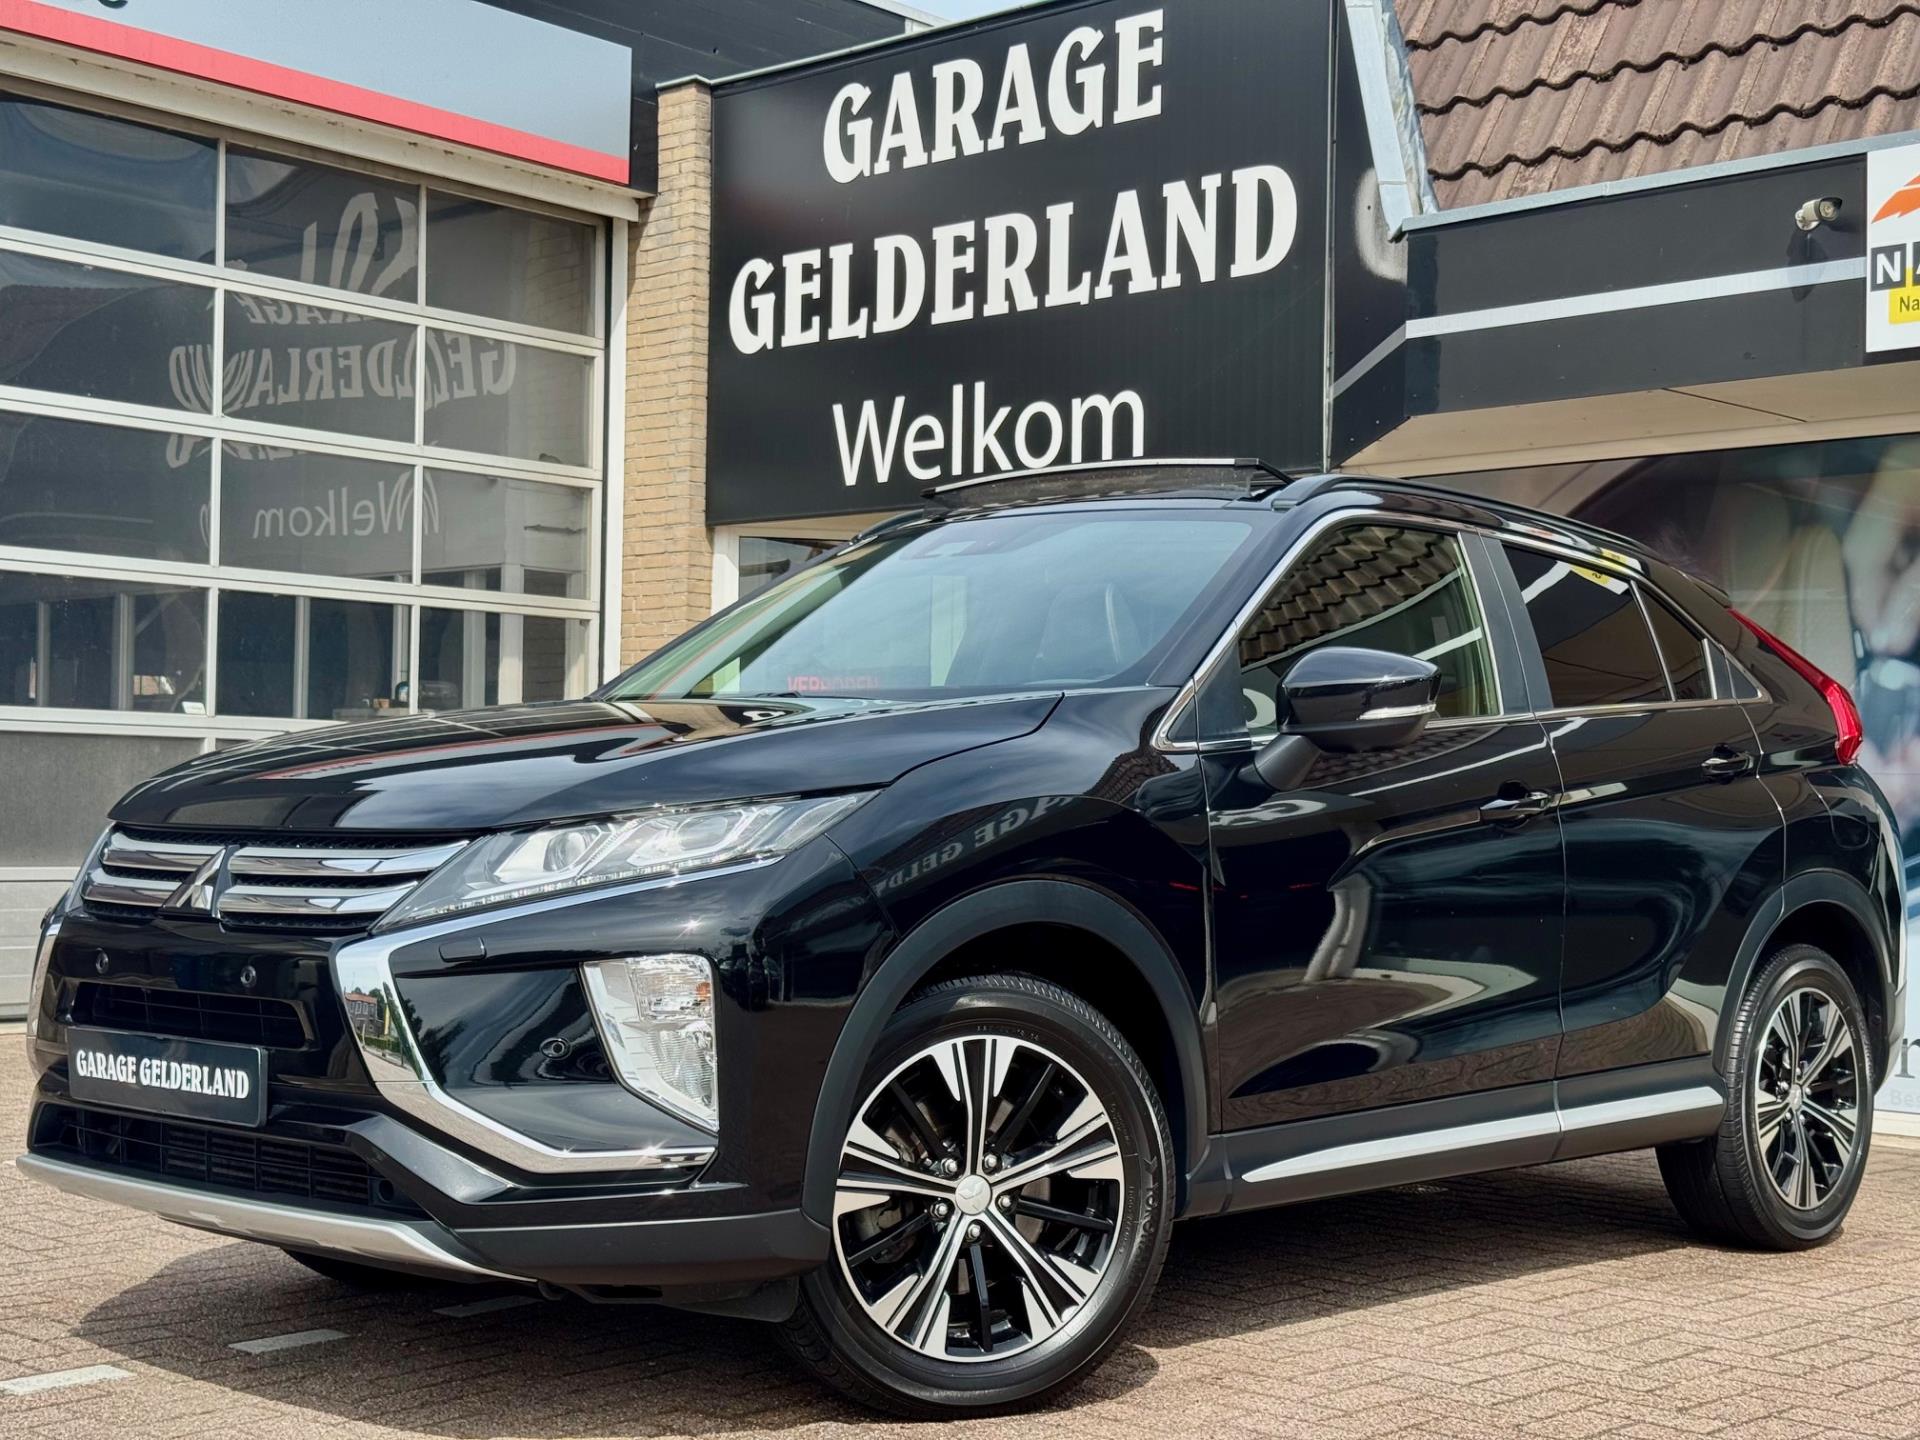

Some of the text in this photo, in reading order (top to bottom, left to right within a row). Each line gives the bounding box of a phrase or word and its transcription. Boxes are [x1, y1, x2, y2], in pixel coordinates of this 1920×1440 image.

[822, 8, 1164, 184] GARAGE
[729, 164, 1298, 355] GELDERLAND
[832, 380, 1144, 486] Welkom
[76, 1050, 250, 1099] GARAGE GELDERLAND
